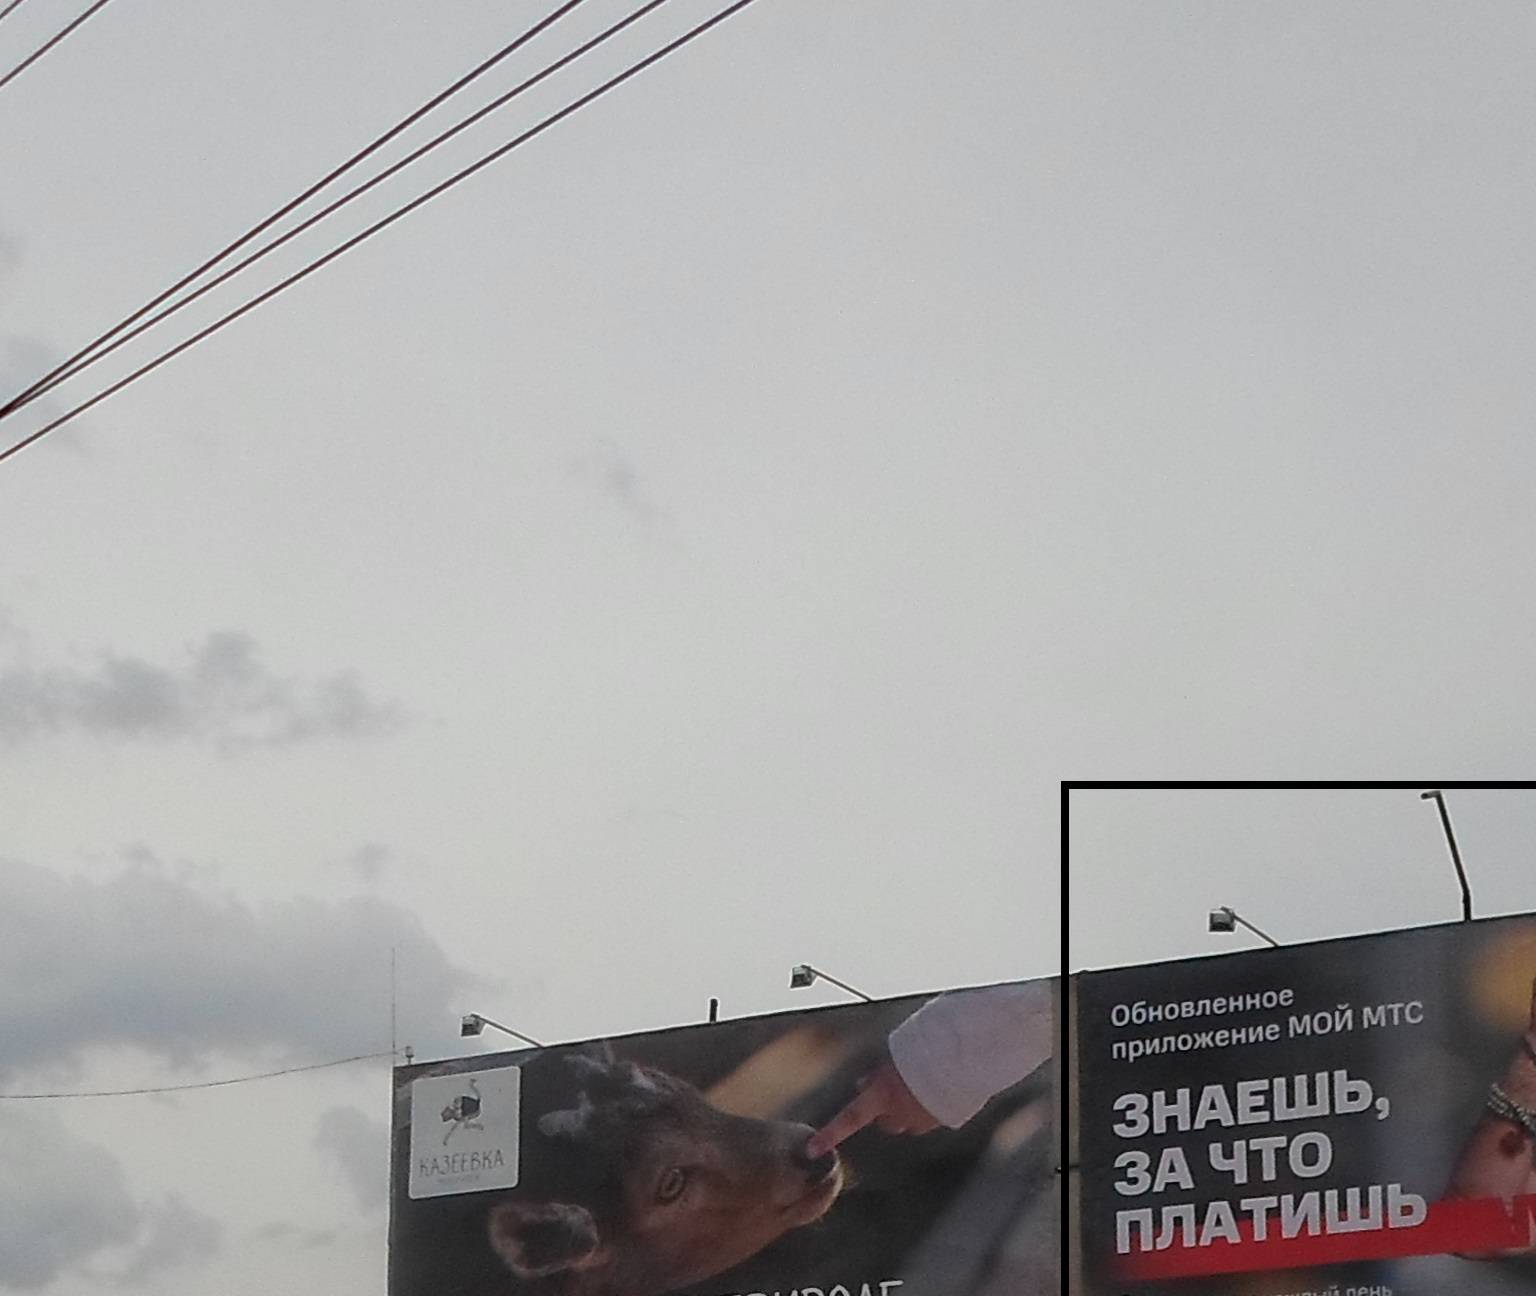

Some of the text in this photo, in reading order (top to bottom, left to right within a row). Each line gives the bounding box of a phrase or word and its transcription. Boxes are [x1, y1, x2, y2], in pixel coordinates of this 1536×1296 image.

[1110, 988, 1294, 1028] Обновленное
[1111, 1000, 1424, 1063] приложение МОЙ МТС
[1112, 1069, 1391, 1139] ЗНАЕШЬ,
[418, 1148, 505, 1178] КАЗЕЕВКА
[1113, 1131, 1333, 1196] ЗА ЧТО
[1115, 1183, 1428, 1254] ПЛАТИШЬ
